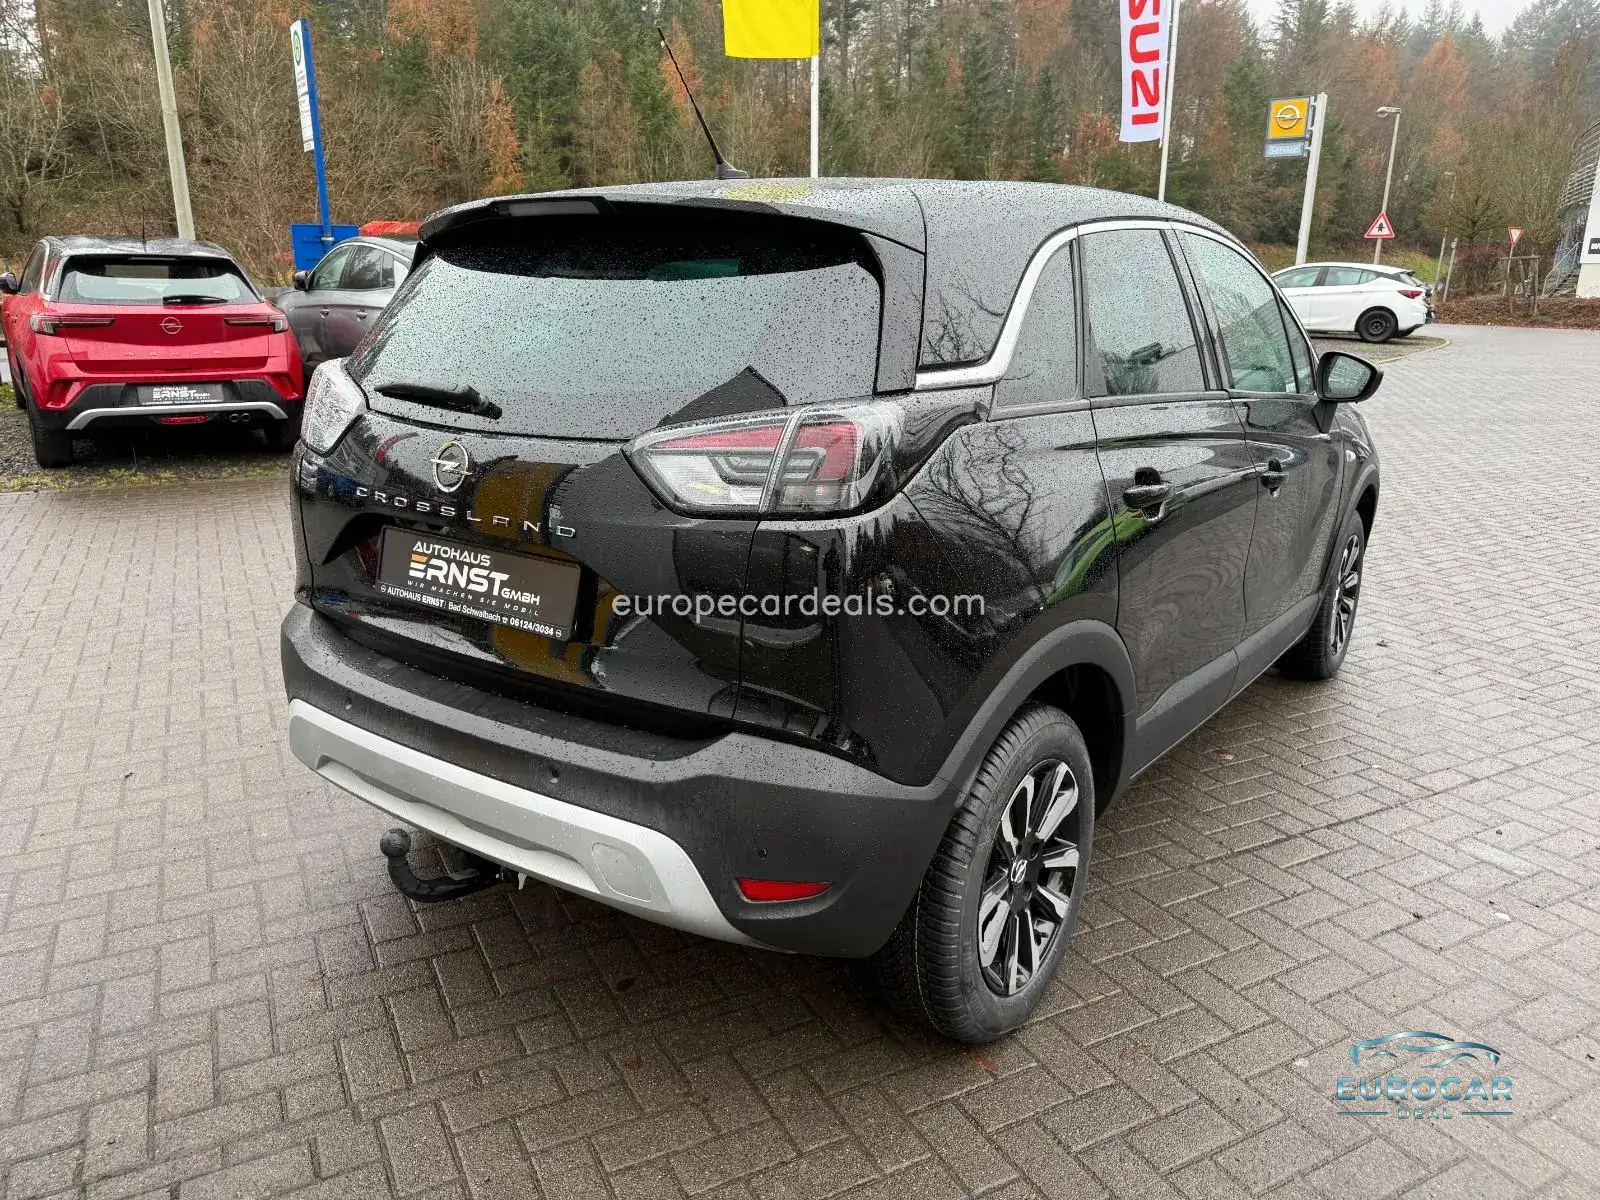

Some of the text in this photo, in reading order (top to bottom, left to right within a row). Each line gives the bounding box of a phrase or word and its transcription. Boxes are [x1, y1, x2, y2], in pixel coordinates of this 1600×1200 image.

[356, 486, 576, 538] CROSSLAND
[412, 540, 491, 567] AUTOHAUS
[407, 580, 539, 616] WIR MACHEN SIE MOBIL
[408, 553, 541, 606] ERNST GMBH
[387, 586, 421, 602] AUTOHAUS
[448, 601, 462, 612] Bad
[461, 604, 501, 622] Schwalbach
[509, 616, 554, 636] 06124/3034
